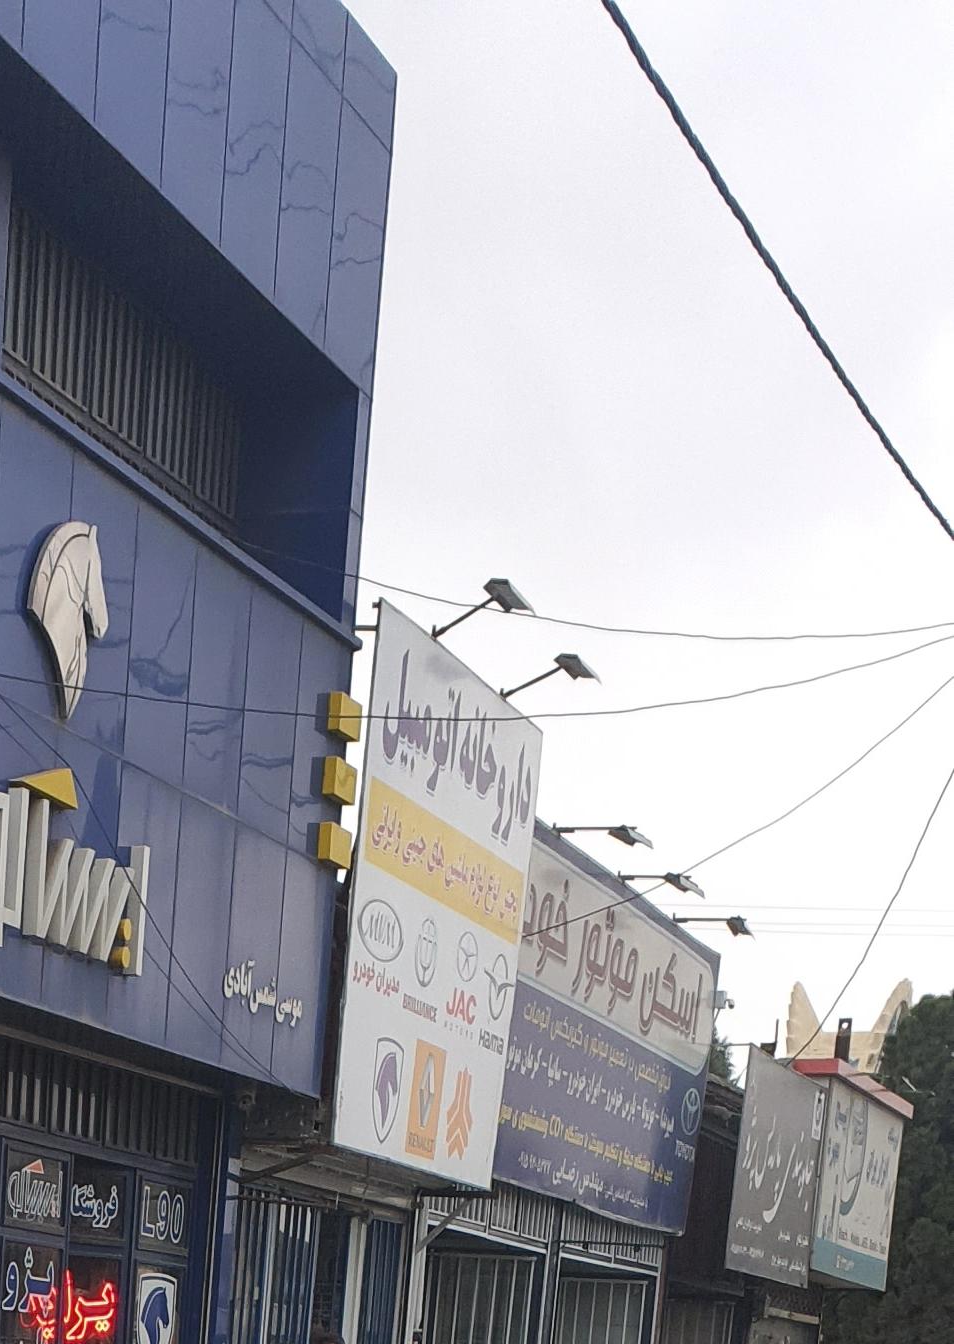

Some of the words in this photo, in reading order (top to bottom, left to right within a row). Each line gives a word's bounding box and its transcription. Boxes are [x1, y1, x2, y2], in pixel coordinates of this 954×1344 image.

[381, 648, 462, 797] اتومبیل
[352, 960, 375, 988] خودرو
[571, 908, 638, 1015] موتور
[224, 960, 256, 1007] آبادی
[249, 976, 277, 1014] شمس
[275, 997, 303, 1029] موسی
[446, 986, 478, 1026] JAC
[141, 1185, 185, 1244] L90
